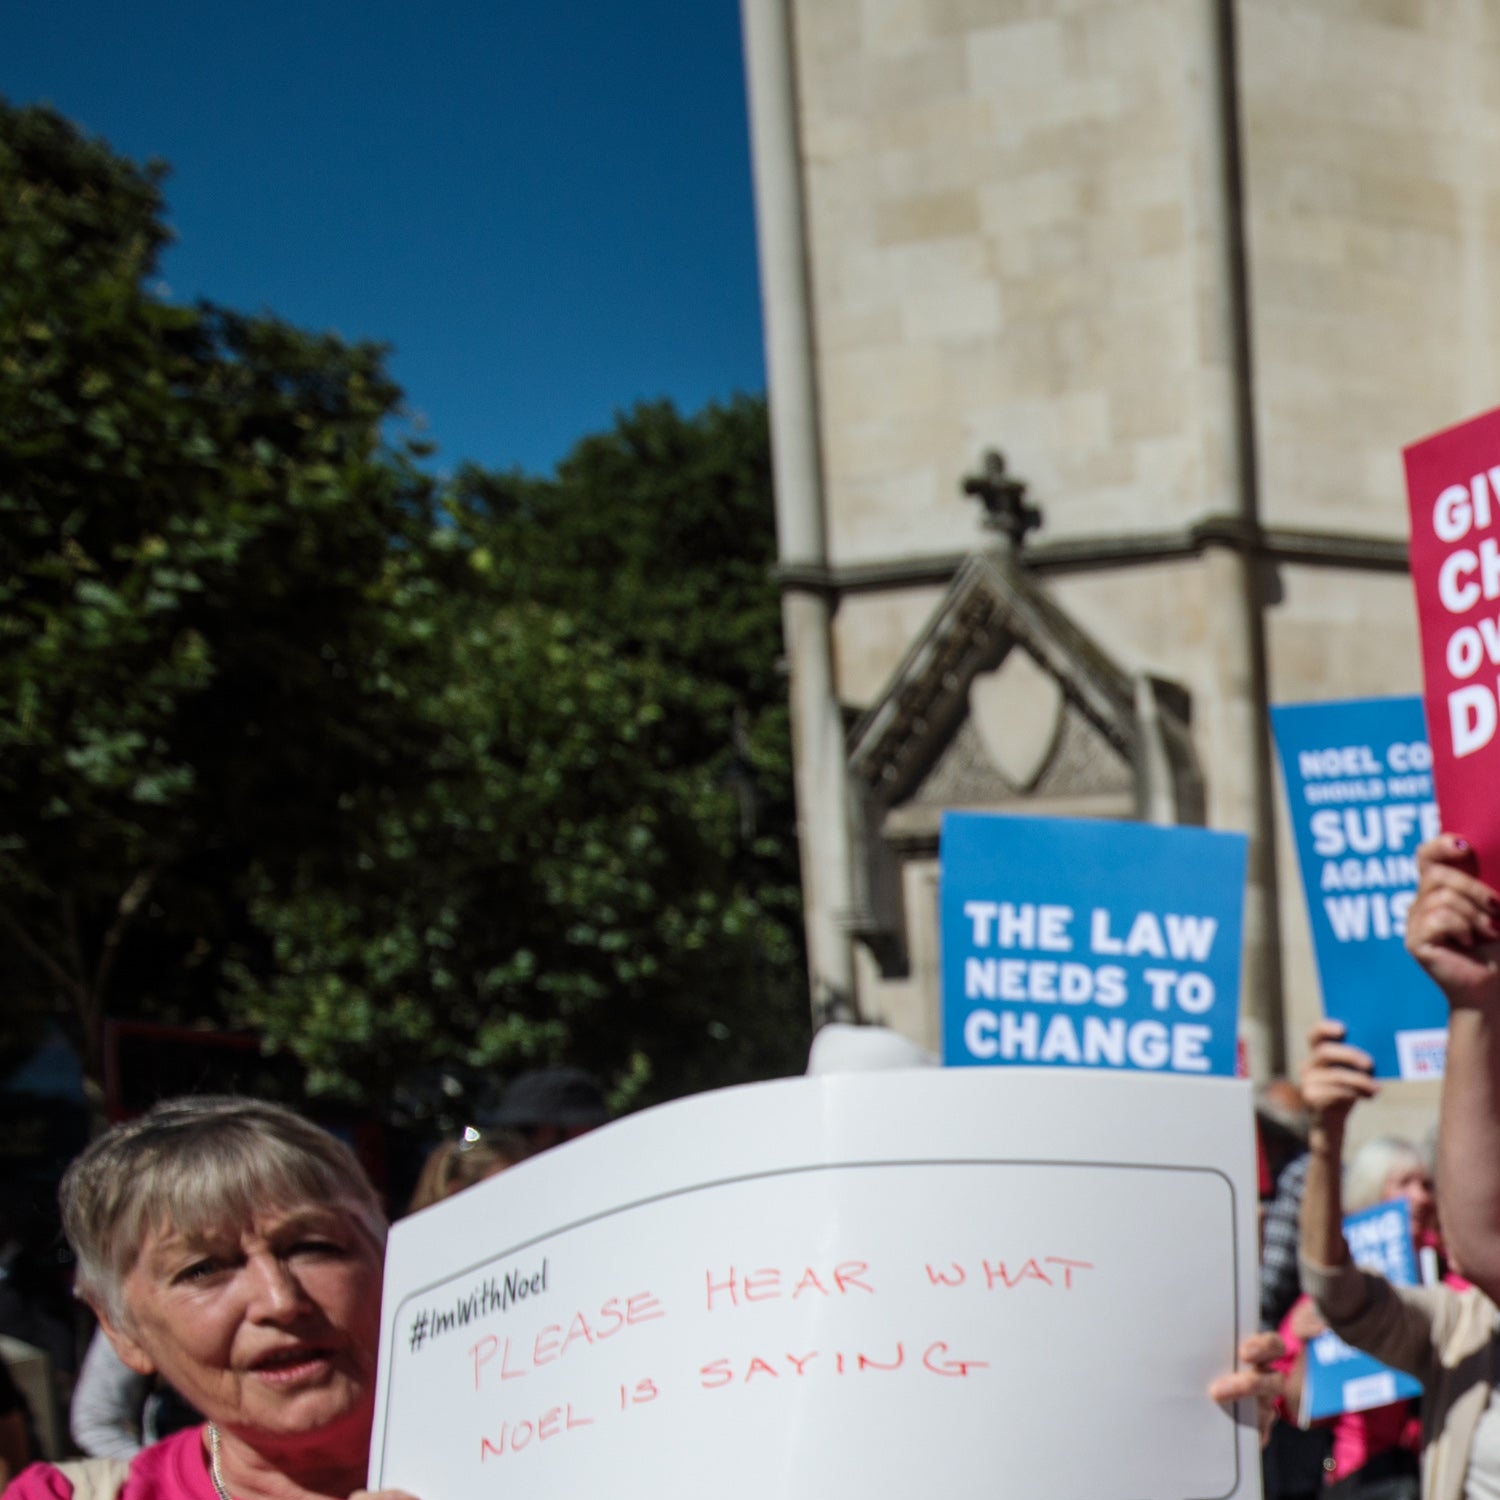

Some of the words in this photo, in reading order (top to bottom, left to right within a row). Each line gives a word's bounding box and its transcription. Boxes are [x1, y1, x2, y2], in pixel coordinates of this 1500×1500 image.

[1298, 744, 1383, 780] NOEL
[964, 902, 1073, 951] THE
[1091, 908, 1217, 962] LAW
[965, 958, 1127, 1008] NEEDS
[1144, 968, 1215, 1013] TO
[964, 1009, 1211, 1072] CHANGE
[409, 1257, 549, 1353] #ImWithNoel
[469, 1291, 665, 1392] PLEASE
[706, 1260, 874, 1311] HEAR
[925, 1256, 1094, 1290] WHAT
[480, 1402, 596, 1464] NOEL
[620, 1378, 659, 1410] IS
[700, 1341, 989, 1389] SAYING
